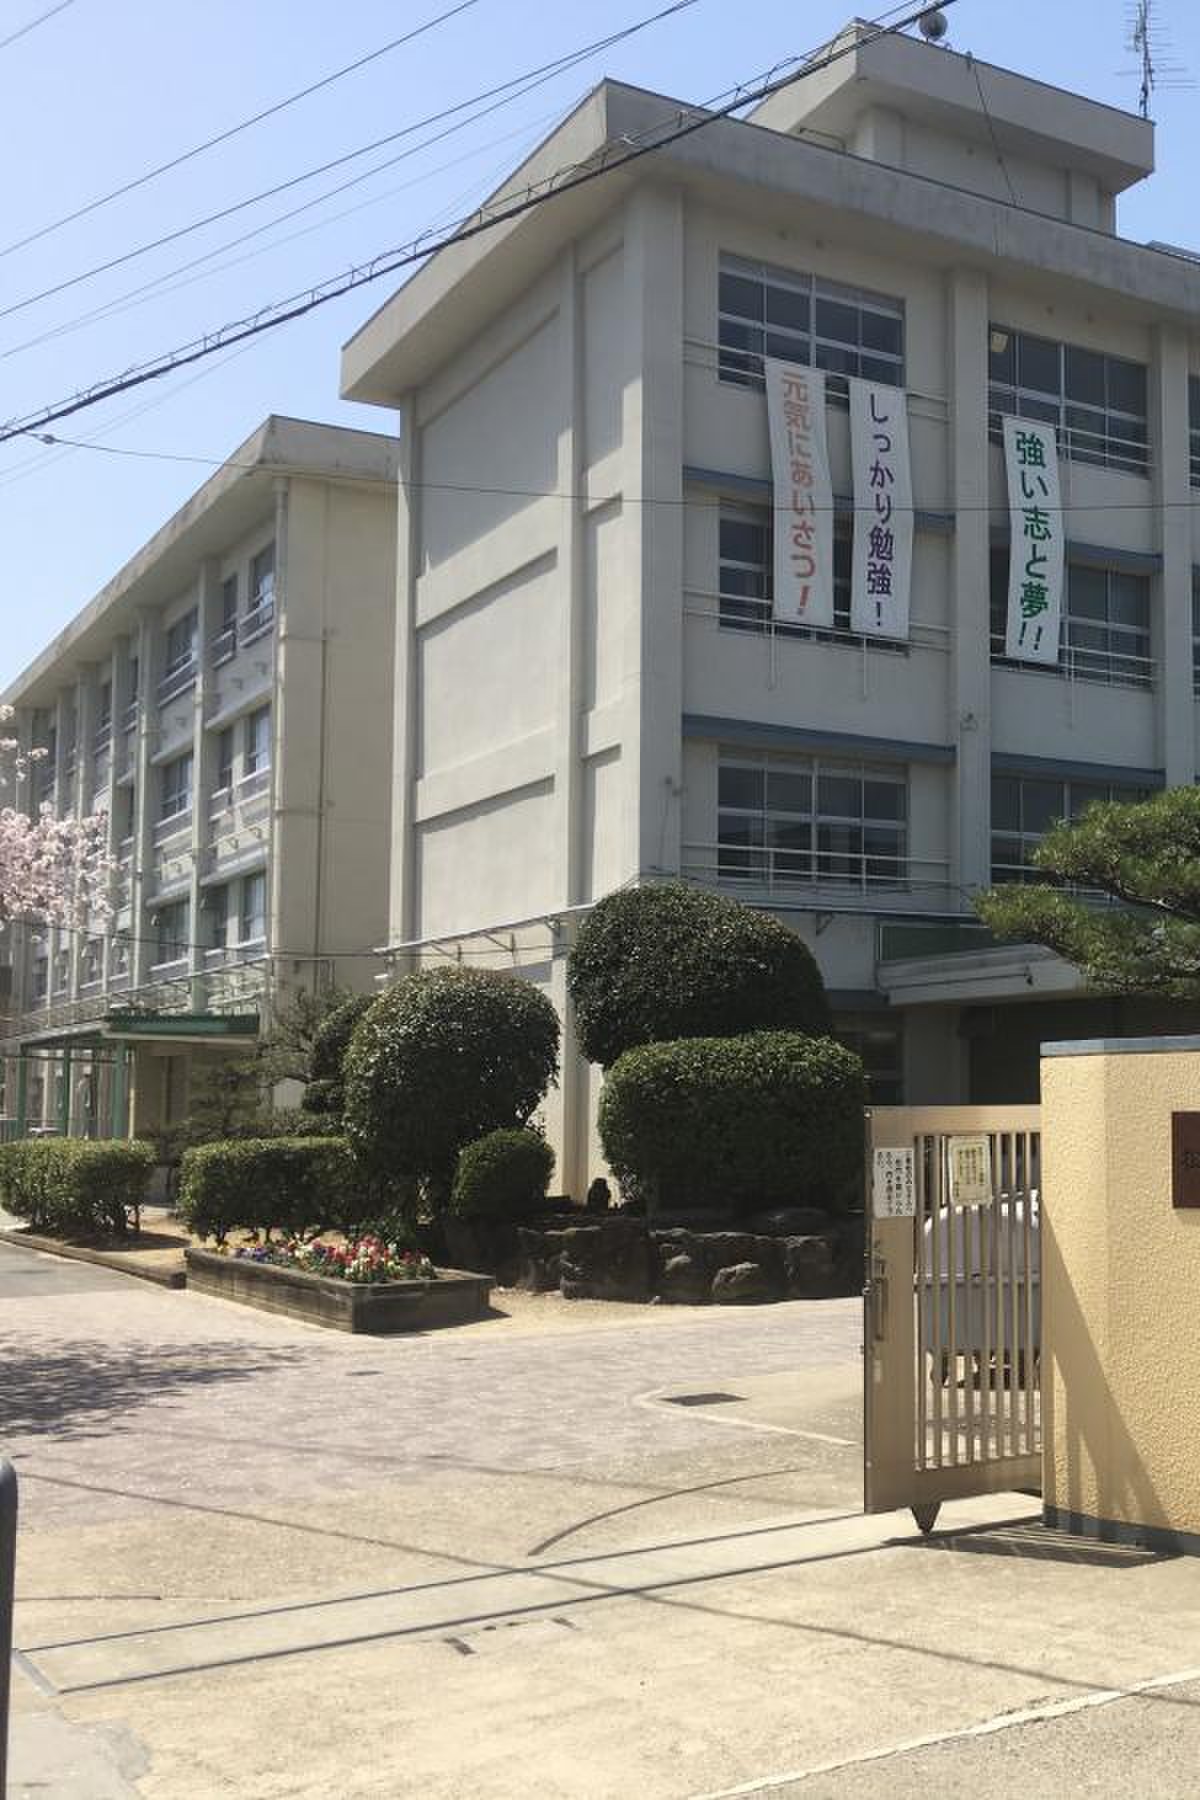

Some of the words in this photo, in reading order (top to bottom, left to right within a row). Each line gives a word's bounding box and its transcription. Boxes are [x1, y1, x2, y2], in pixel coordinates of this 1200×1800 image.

[867, 393, 895, 627] しっかり勉強！
